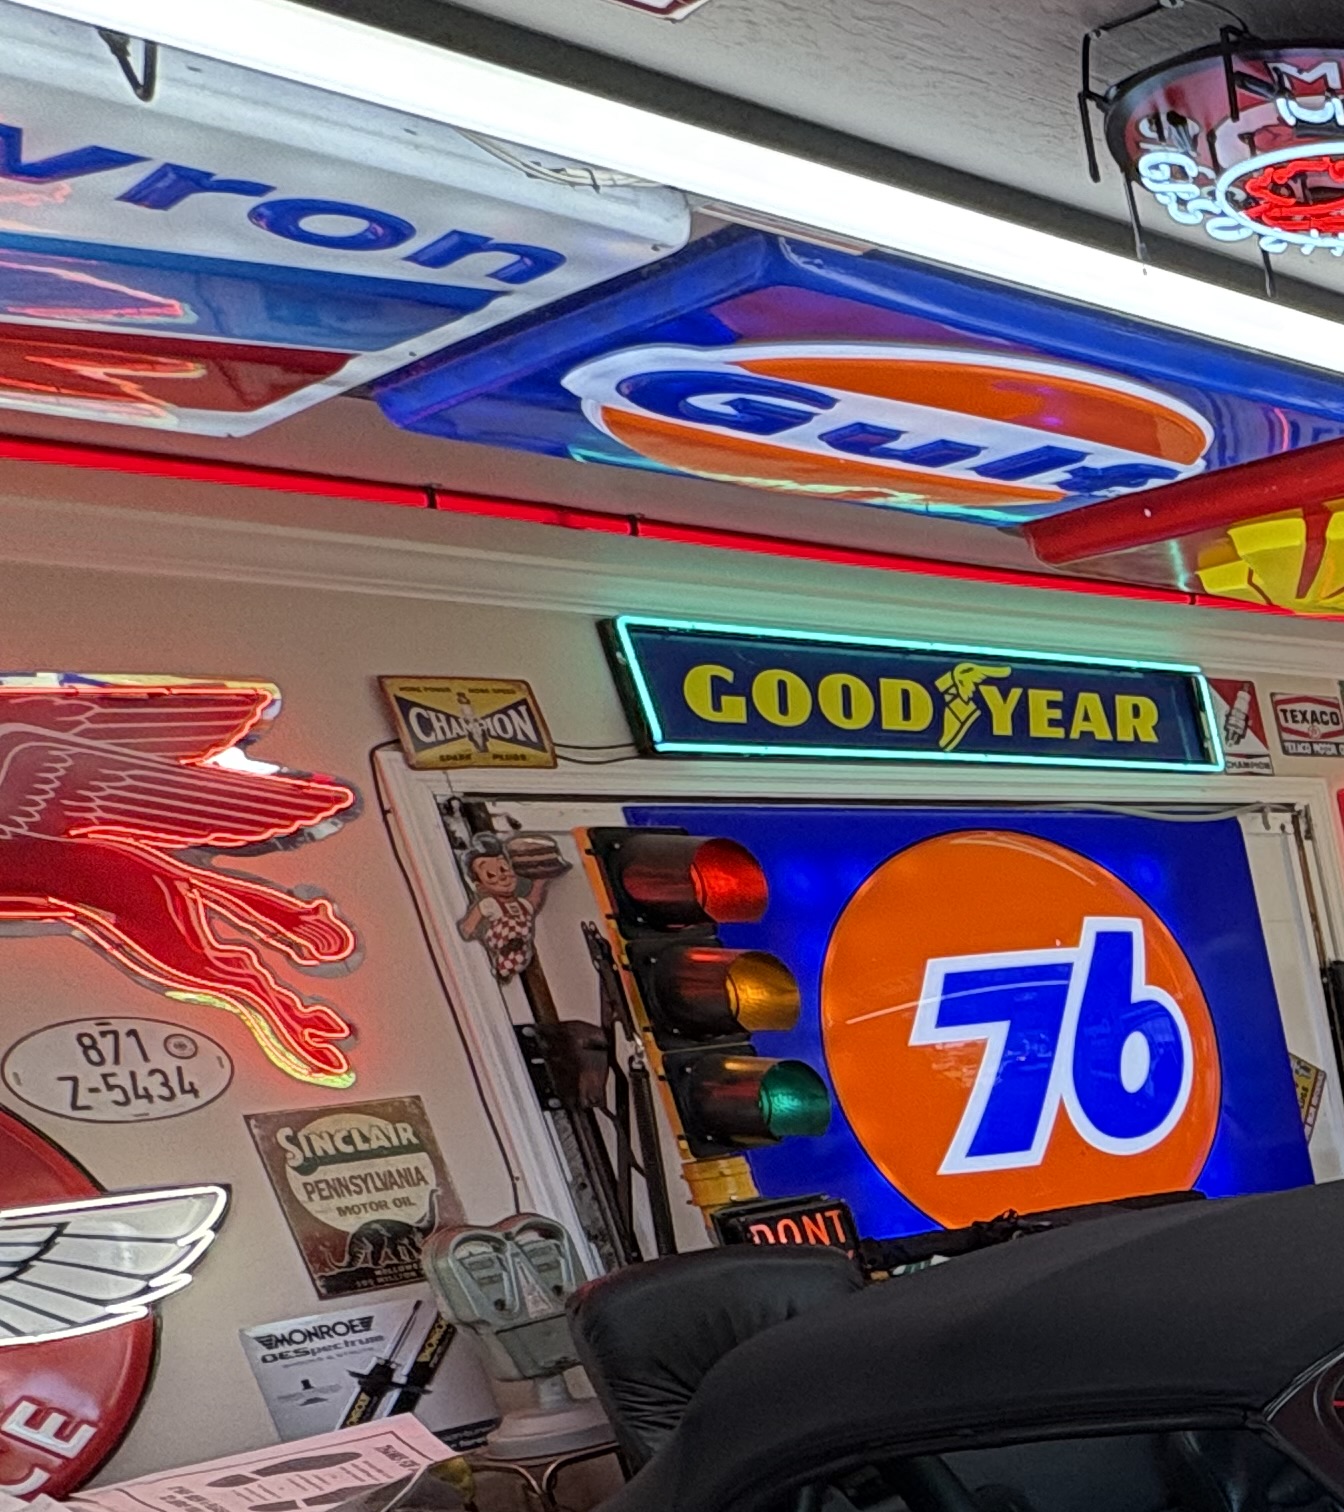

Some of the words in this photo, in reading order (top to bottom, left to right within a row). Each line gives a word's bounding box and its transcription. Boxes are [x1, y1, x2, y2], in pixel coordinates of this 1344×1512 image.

[616, 370, 1182, 495] Gulf
[408, 704, 540, 745] CHAMPION
[1280, 707, 1340, 726] TEXACO
[77, 1029, 151, 1067] 871
[908, 916, 1194, 1175] 76
[57, 1065, 200, 1112] Z-5434
[276, 1122, 420, 1168] SINCLAIR
[302, 1165, 430, 1203] PENNSYLVANIA
[336, 1200, 391, 1218] MOTOR
[394, 1197, 417, 1209] OIL
[749, 1209, 847, 1246] DONT
[272, 1317, 366, 1347] MONROE
